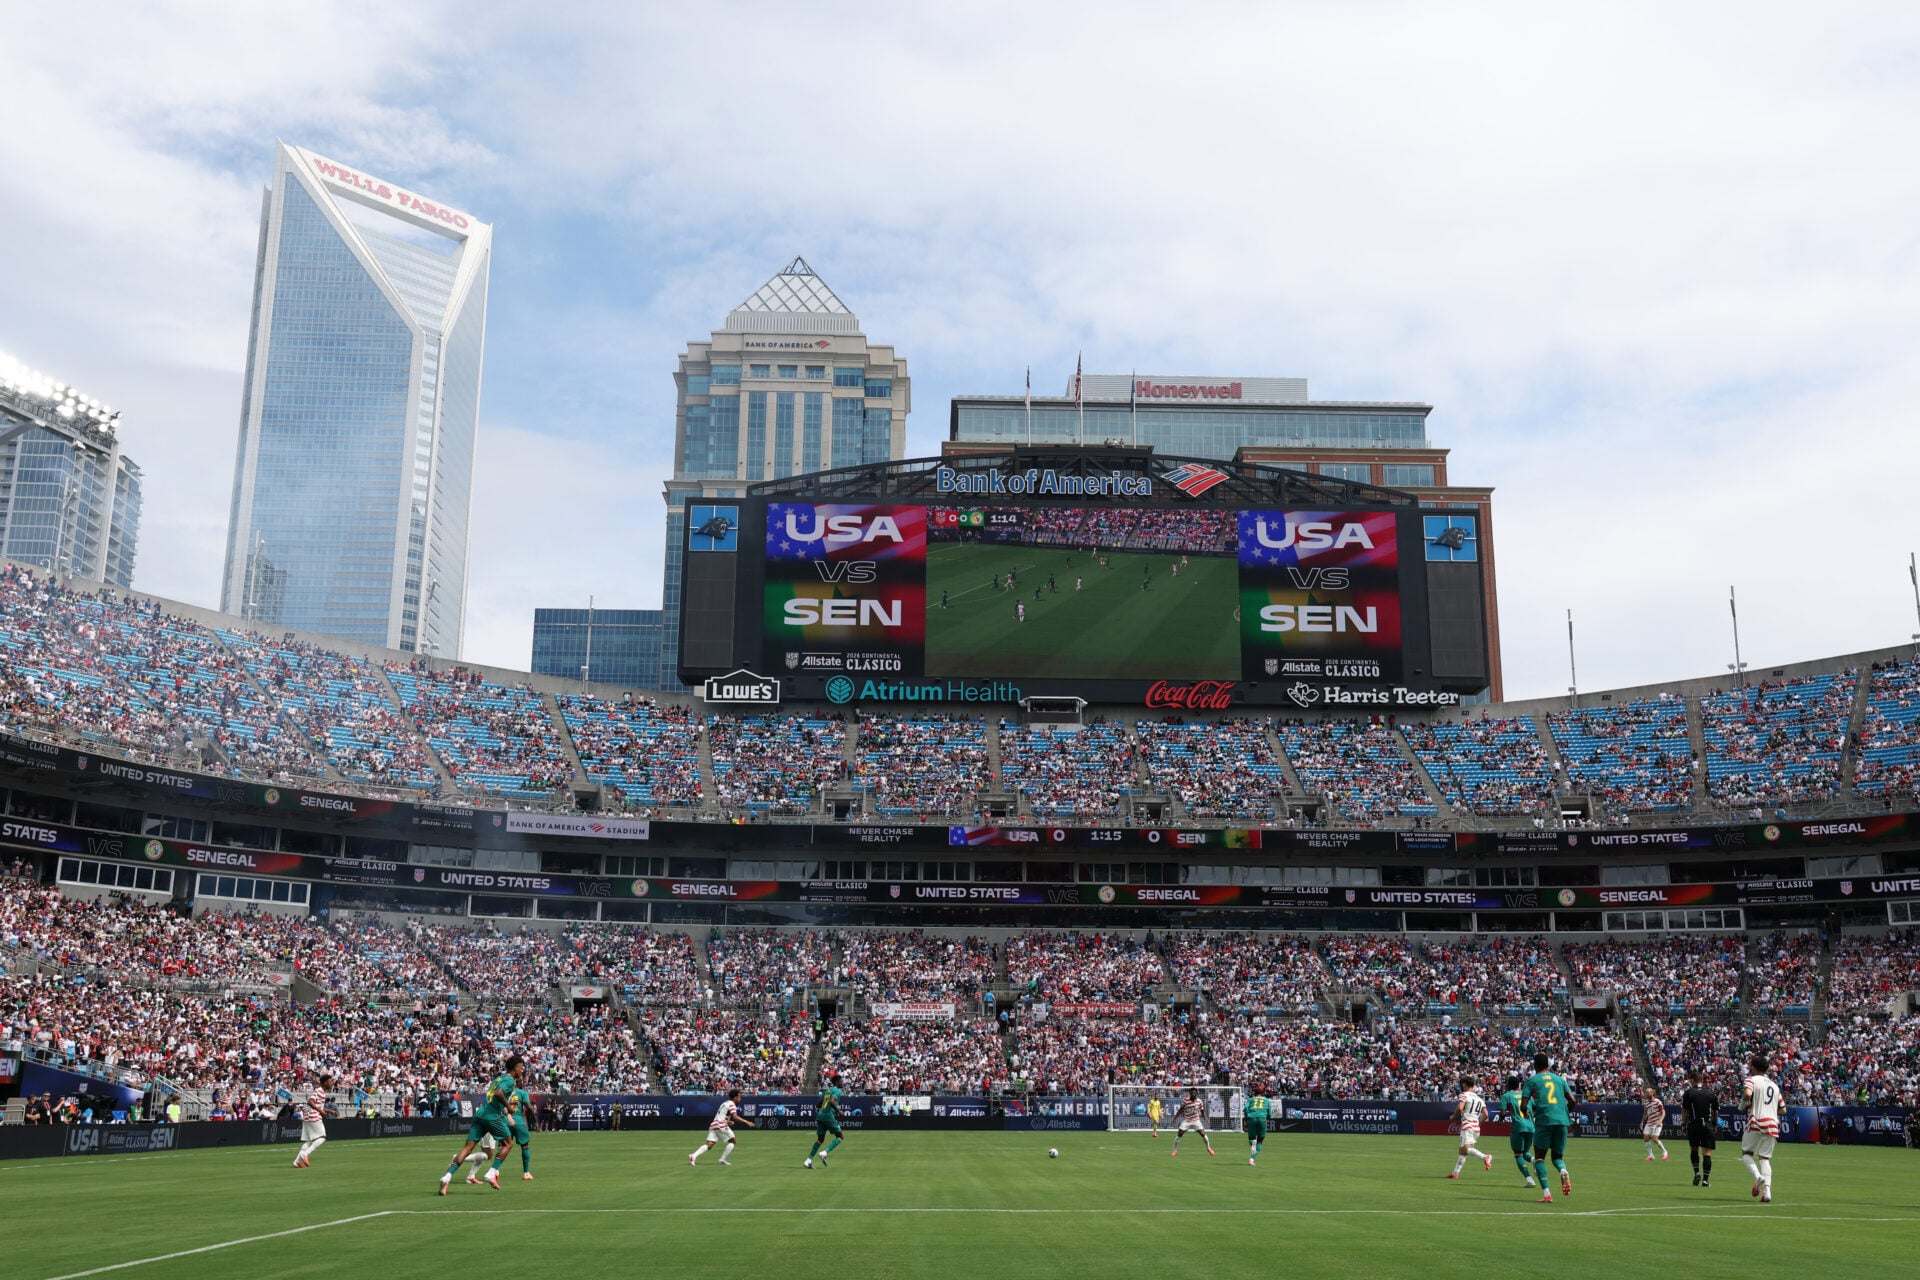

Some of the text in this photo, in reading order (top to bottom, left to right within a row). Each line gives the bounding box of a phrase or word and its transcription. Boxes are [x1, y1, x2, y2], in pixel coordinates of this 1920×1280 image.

[314, 158, 469, 229] WELLS FARGO
[1136, 380, 1242, 399] Honeywell
[936, 467, 1152, 496] Bank of America
[991, 514, 1018, 523] 1:14
[785, 514, 904, 542] USA
[1256, 521, 1375, 549] USA
[814, 560, 877, 584] VS
[1287, 567, 1350, 590] VS
[783, 598, 902, 627] SEN
[1259, 604, 1378, 633] SEN
[801, 656, 841, 666] Allstate
[1281, 662, 1321, 672] Allstate
[712, 682, 773, 700] LOWE'S
[859, 680, 1021, 702] Atrium Health
[1323, 686, 1459, 705] Harris Teeter
[100, 761, 193, 790] UNITED STATES
[300, 795, 356, 812] SENEGAL
[2, 822, 58, 844] STATES
[510, 820, 646, 835] BANK OF AMERICA STADIUM
[849, 827, 914, 836] NEVER CHASE
[1801, 823, 1866, 836] SENEGAL
[1009, 831, 1039, 842] USA
[1053, 829, 1065, 842] 0
[1090, 830, 1122, 841] 1:15
[1148, 831, 1160, 843] 0
[1176, 833, 1206, 844] SEN
[1296, 832, 1361, 841] NEVER CHASE
[1591, 832, 1689, 846] UNITED STATES
[87, 837, 123, 858] VS
[1308, 840, 1348, 848] REALITY
[186, 849, 257, 869] SENEGAL
[441, 872, 551, 890] UNITED STATES
[578, 881, 612, 897] VS
[672, 883, 737, 896] SENEGAL
[916, 887, 1020, 900] UNITED STATES
[1047, 889, 1080, 903] VS
[1137, 889, 1200, 901] SENEGAL
[1599, 889, 1668, 903] SENEGAL
[1370, 892, 1476, 905] UNITED STATES
[1504, 893, 1538, 908] VS
[1544, 1081, 1558, 1104] 2
[1764, 1085, 1774, 1105] 9
[1252, 1099, 1264, 1109] 11
[1469, 1099, 1481, 1115] 14
[1046, 1119, 1081, 1130] Allstate
[1328, 1120, 1399, 1134] Volkswagen
[1580, 1125, 1608, 1135] TRULY
[69, 1128, 100, 1152] USA
[149, 1127, 175, 1149] SEN
